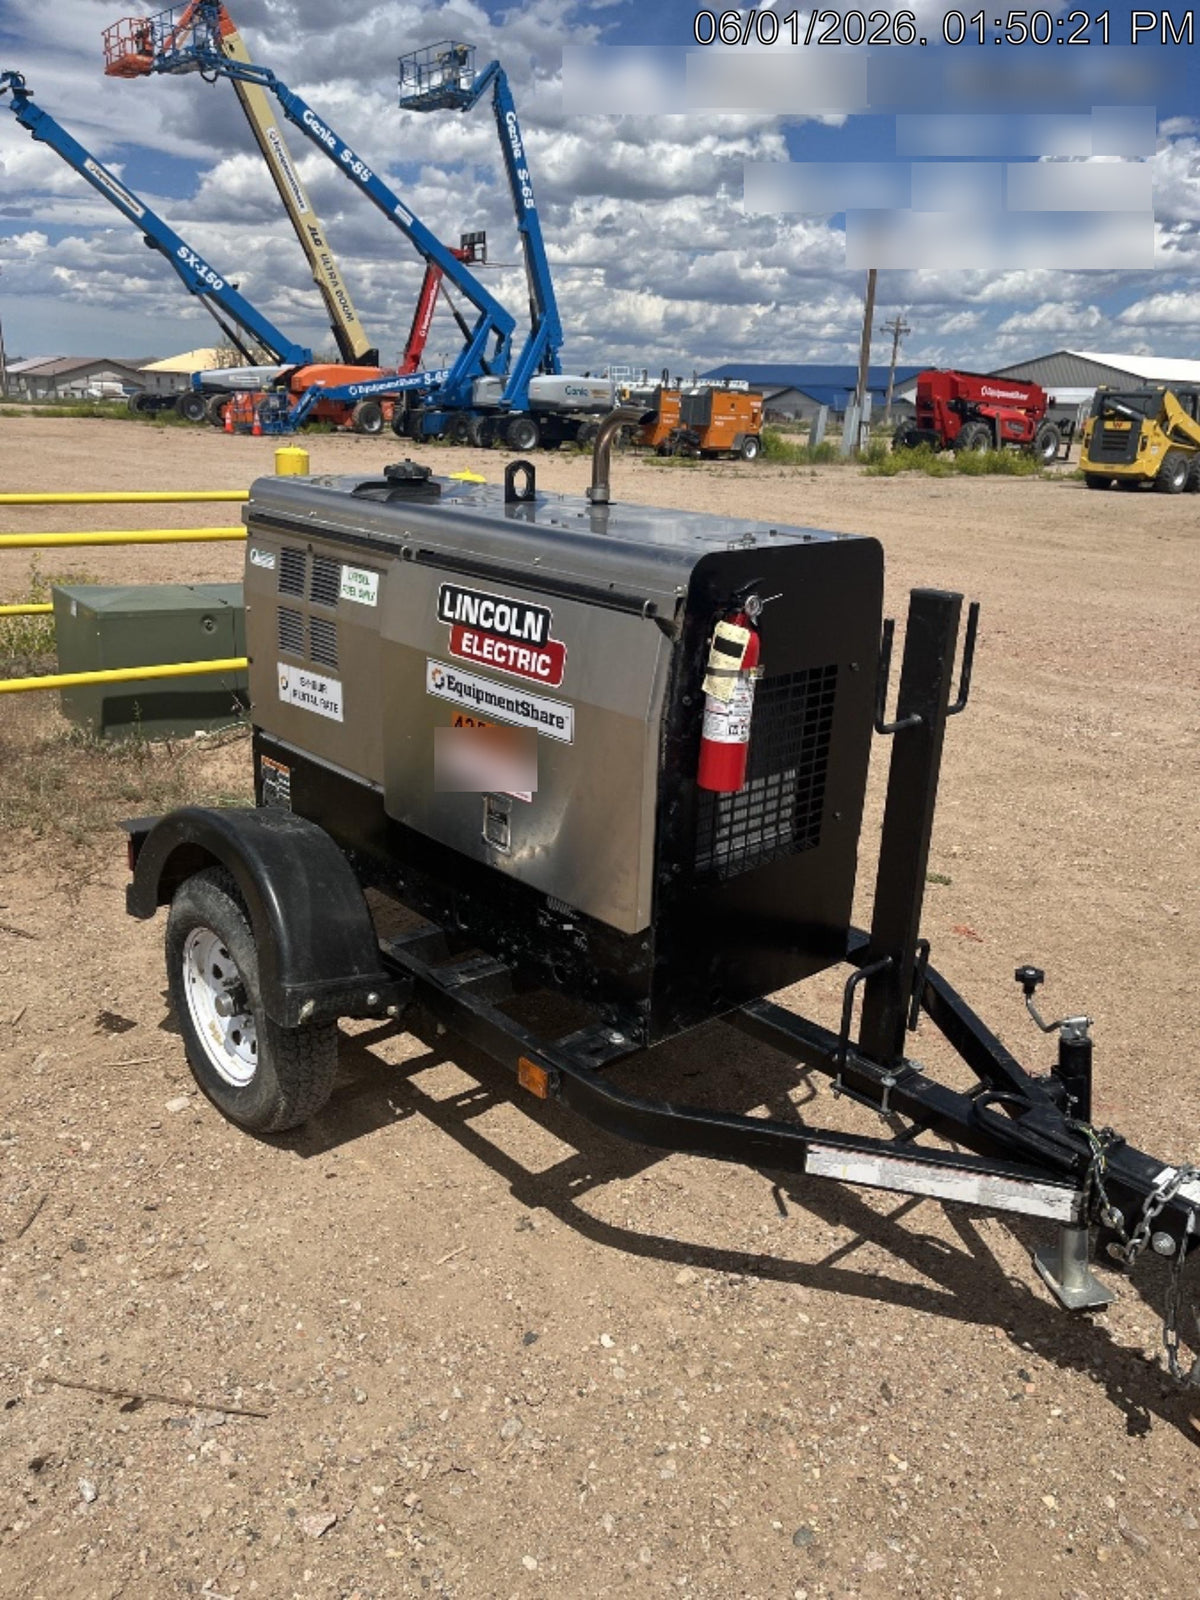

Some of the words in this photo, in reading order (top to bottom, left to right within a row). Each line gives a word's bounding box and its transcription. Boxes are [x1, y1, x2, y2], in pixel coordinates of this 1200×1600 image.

[303, 110, 336, 150] Genie
[340, 149, 373, 182] S-85
[506, 111, 522, 160] Genie
[517, 168, 535, 209] S-65
[176, 246, 224, 291] SX-150
[320, 253, 340, 288] ULTRA
[443, 590, 544, 643] LINCOLN
[461, 631, 552, 677] ELECTRIC
[446, 675, 565, 730] EquipmentShare
